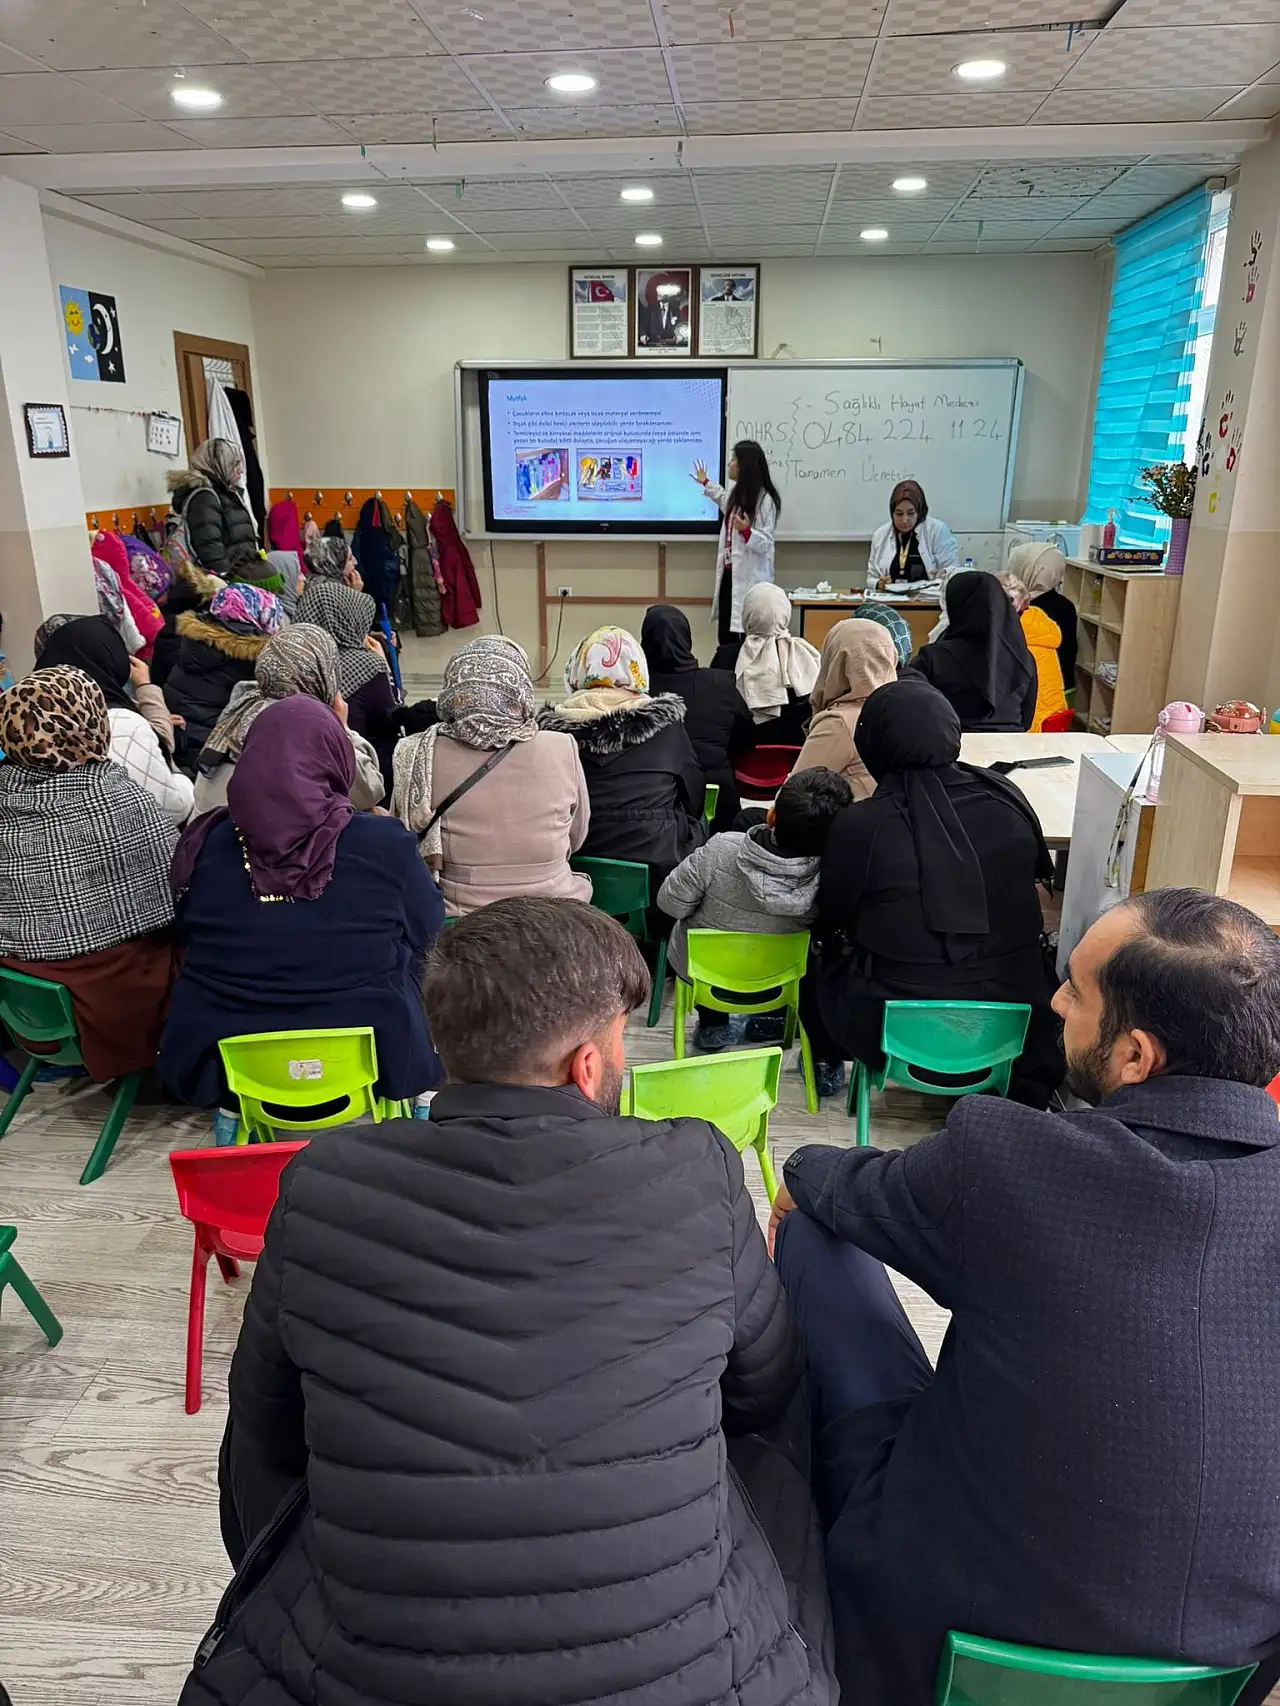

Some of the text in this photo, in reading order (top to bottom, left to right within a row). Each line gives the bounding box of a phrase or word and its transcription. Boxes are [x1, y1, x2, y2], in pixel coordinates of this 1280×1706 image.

[891, 393, 925, 413] Hayat
[735, 420, 788, 442] MHRS
[803, 420, 873, 450] 0484
[883, 419, 934, 443] 224
[951, 419, 964, 439] 11
